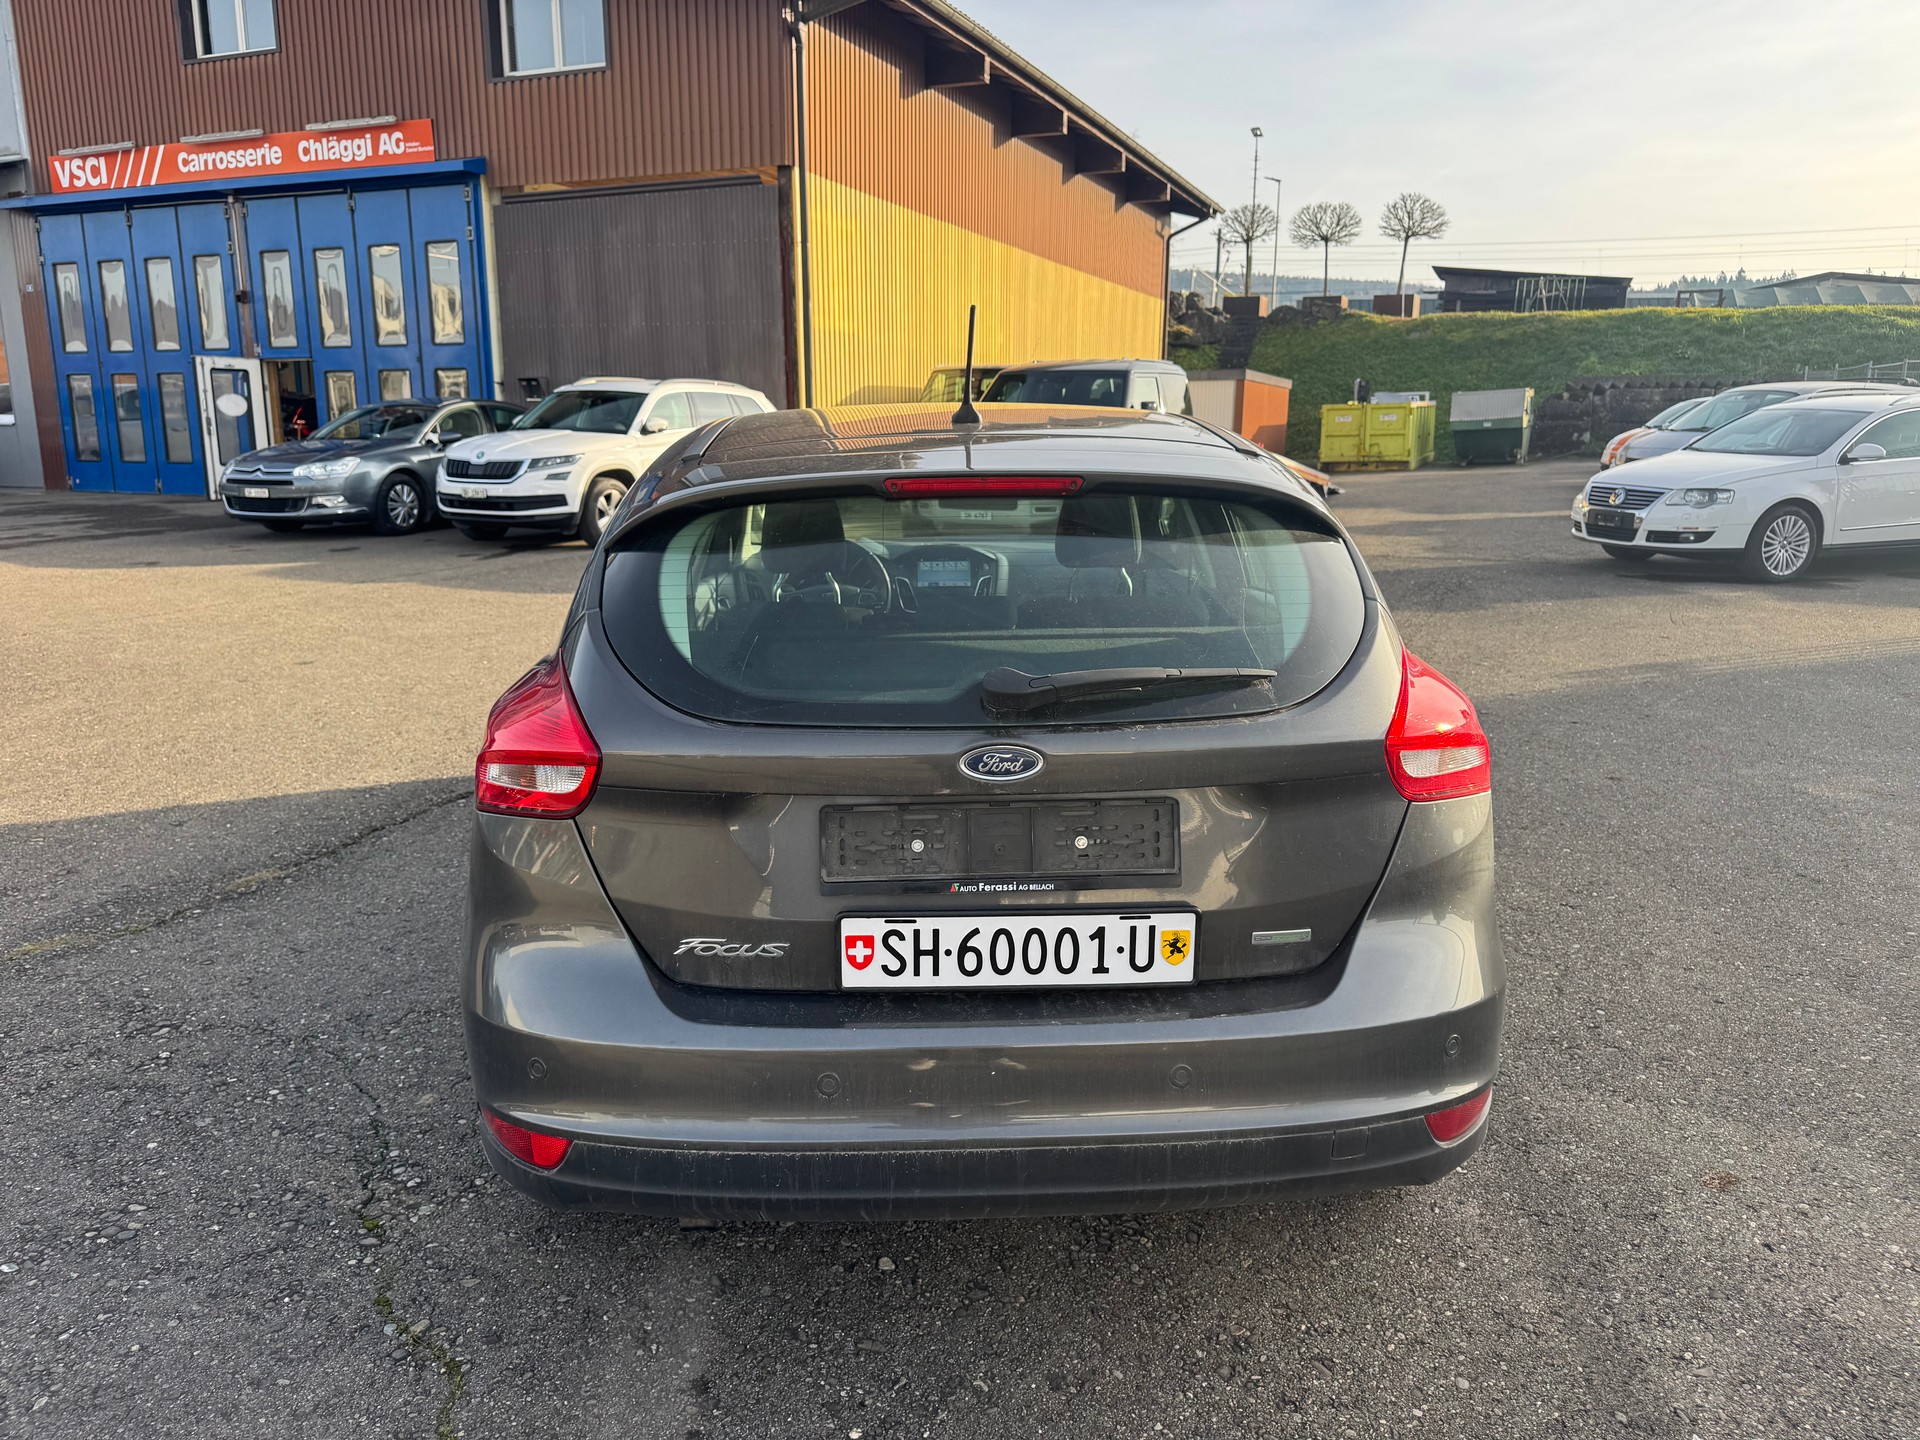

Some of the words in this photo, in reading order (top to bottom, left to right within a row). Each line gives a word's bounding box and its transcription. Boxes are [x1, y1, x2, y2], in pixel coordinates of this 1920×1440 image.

[53, 156, 108, 188] VSCI
[177, 143, 283, 173] Carrosserie
[297, 133, 373, 162] Chläggi
[378, 131, 405, 155] AG
[978, 753, 1024, 772] Ford
[979, 881, 1017, 892] Ferassi
[1029, 883, 1055, 891] BELLACH
